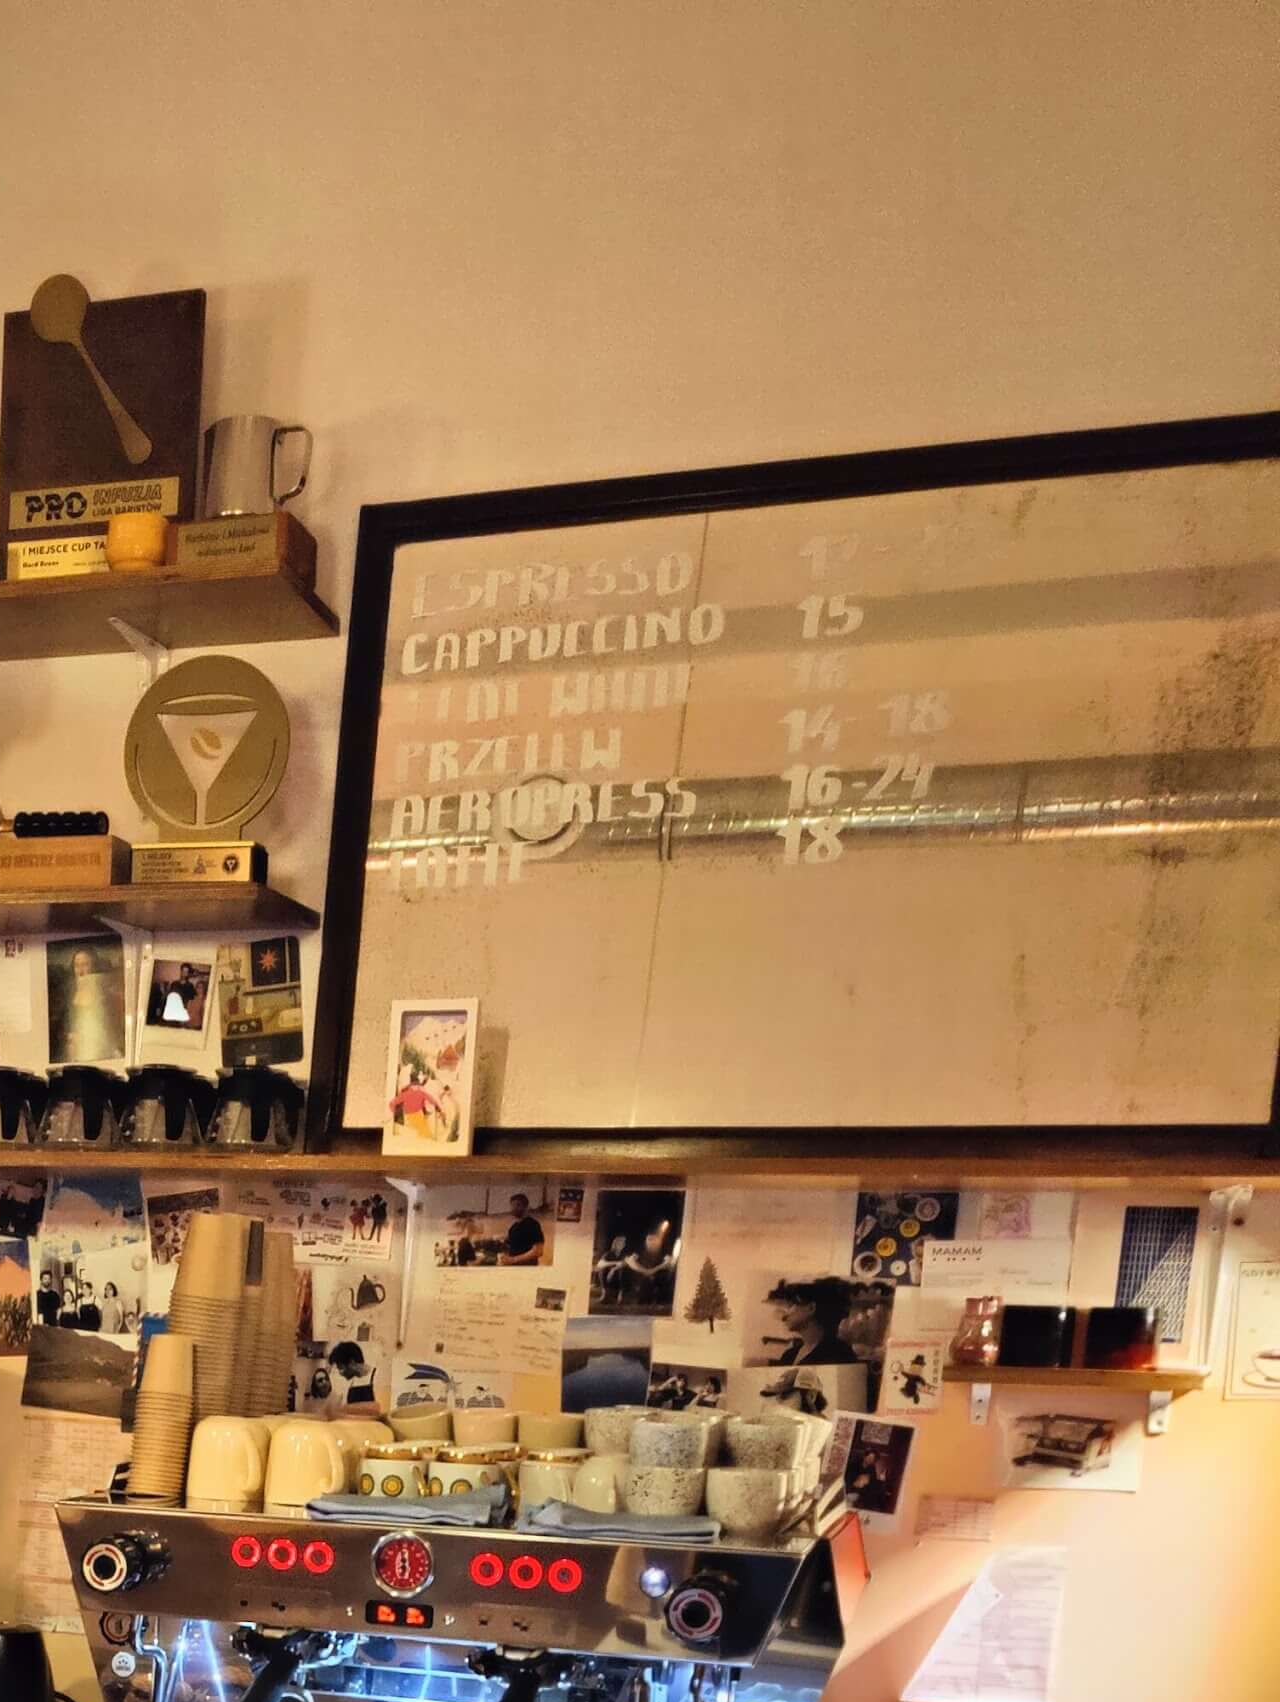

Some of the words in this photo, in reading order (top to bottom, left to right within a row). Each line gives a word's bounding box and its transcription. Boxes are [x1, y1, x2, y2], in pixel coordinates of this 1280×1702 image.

[25, 492, 87, 522] PRO
[28, 543, 69, 555] MIEJSCE
[71, 542, 91, 552] CUP
[400, 602, 726, 676] CAPPUCCINO
[797, 593, 865, 640] 15
[390, 777, 698, 839] AEROPRESS
[776, 814, 845, 865] 18
[932, 1246, 983, 1256] MAMAM
